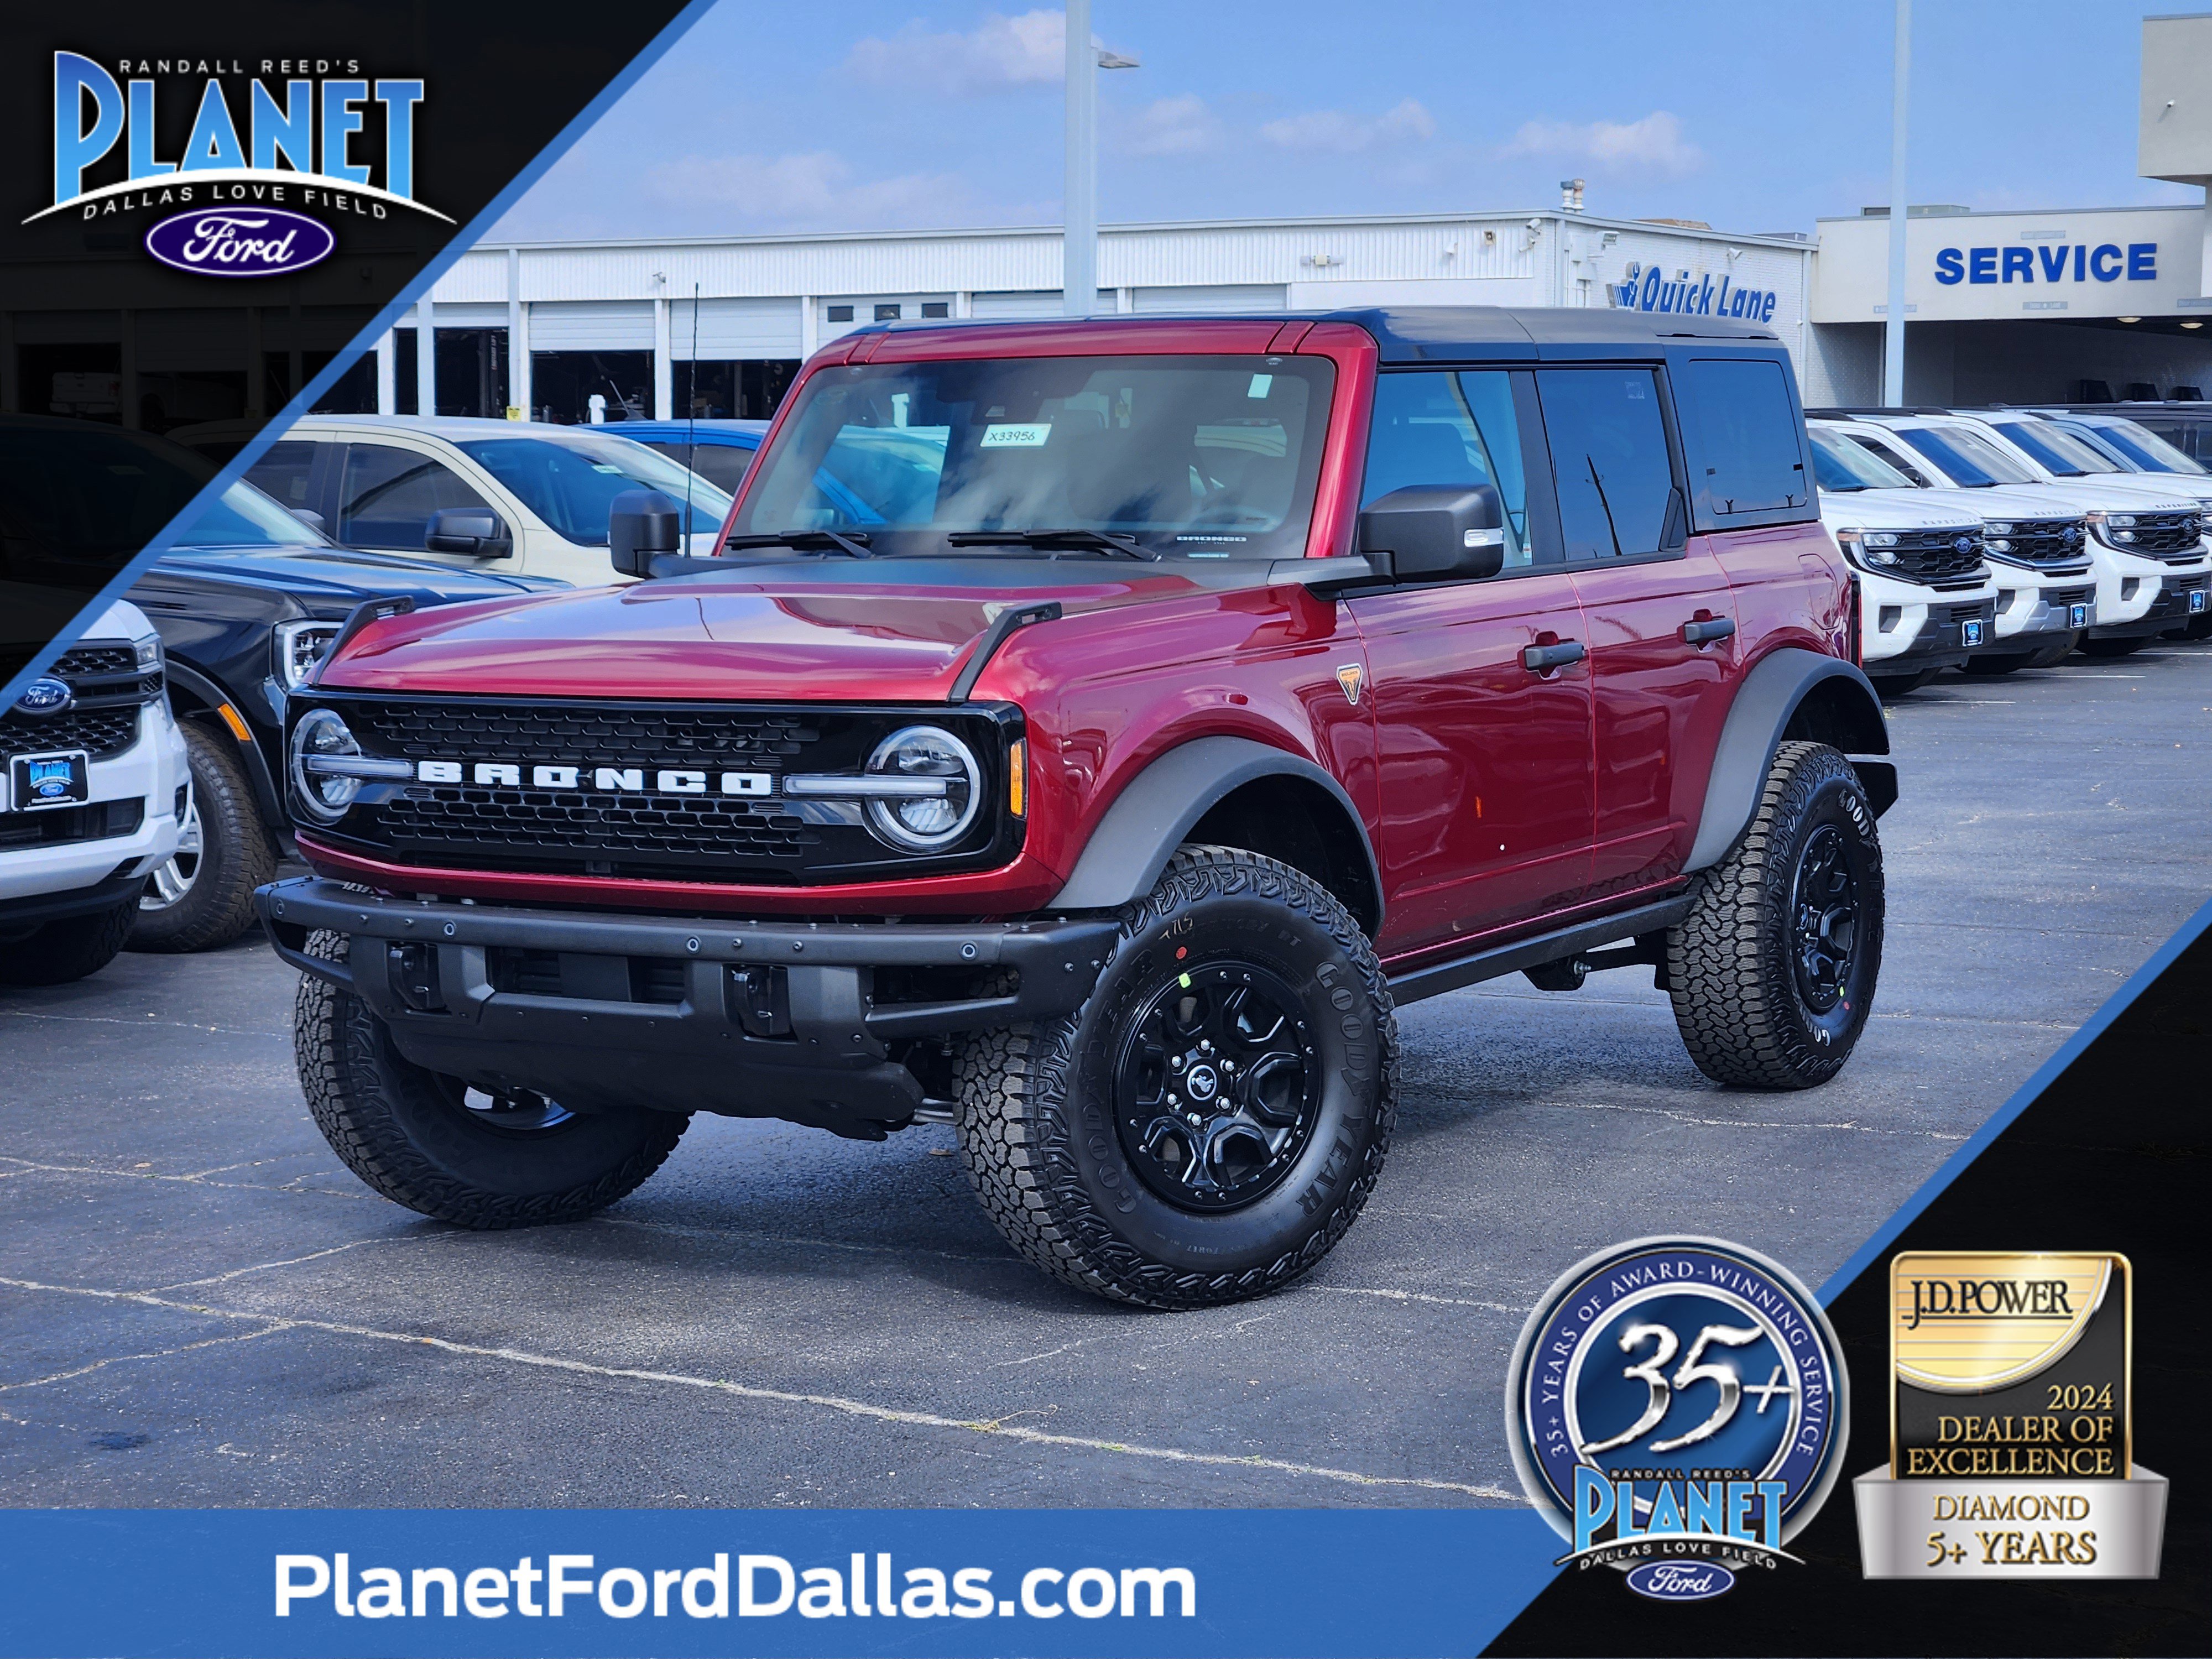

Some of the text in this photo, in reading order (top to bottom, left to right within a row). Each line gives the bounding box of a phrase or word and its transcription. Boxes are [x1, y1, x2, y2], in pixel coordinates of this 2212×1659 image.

[1934, 243, 2157, 285] SERVICE
[1641, 266, 1776, 323] Quick Lane
[989, 431, 1035, 441] X33956
[25, 686, 58, 705] Ford
[418, 760, 772, 795] BRONCO
